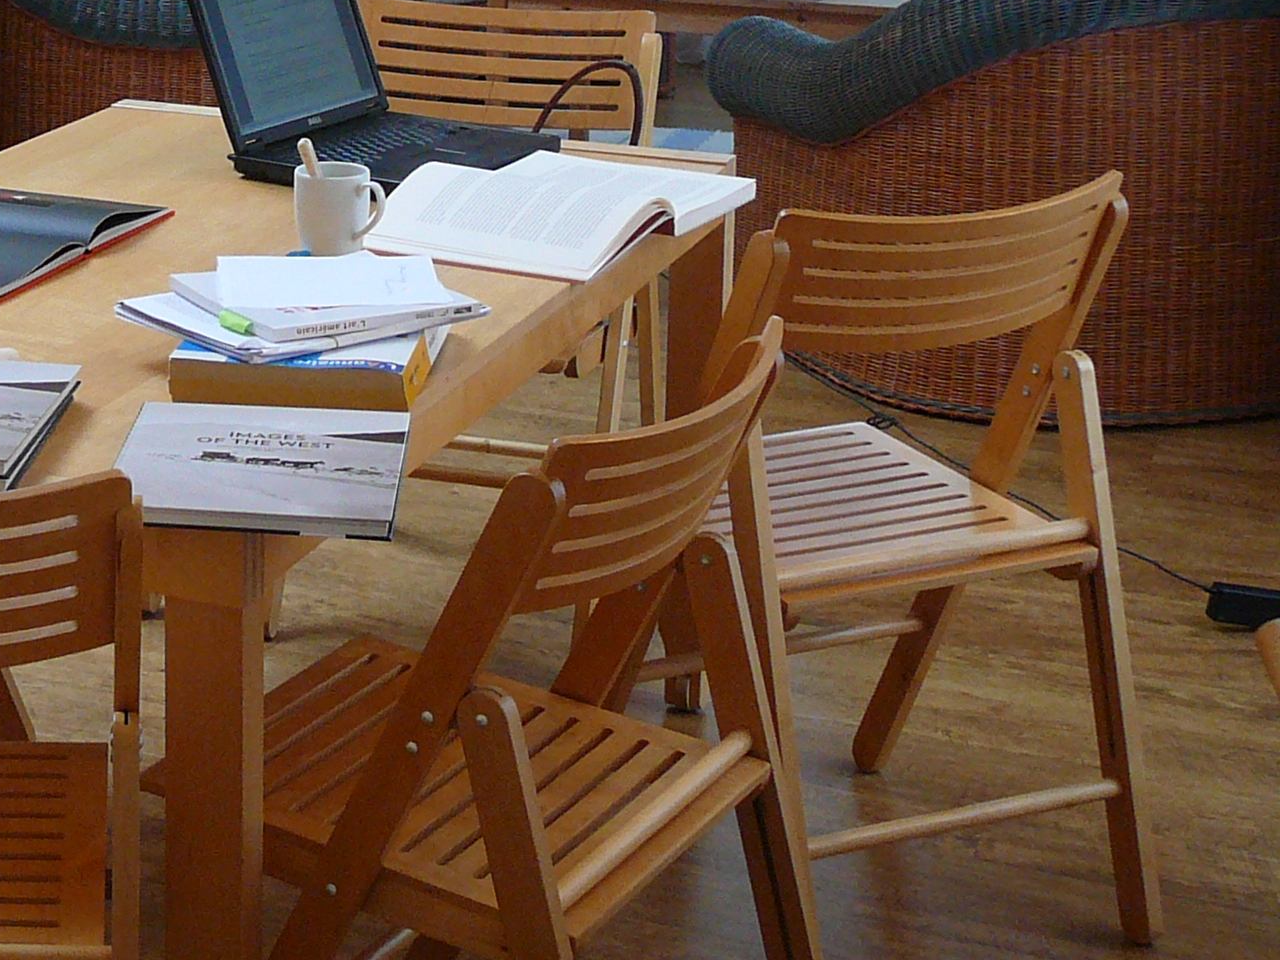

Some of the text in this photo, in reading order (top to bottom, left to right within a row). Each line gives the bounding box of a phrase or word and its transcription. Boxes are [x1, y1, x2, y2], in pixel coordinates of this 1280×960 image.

[342, 320, 366, 330] L'art
[229, 431, 306, 440] IMAGES
[196, 436, 335, 449] OF THE WEST
